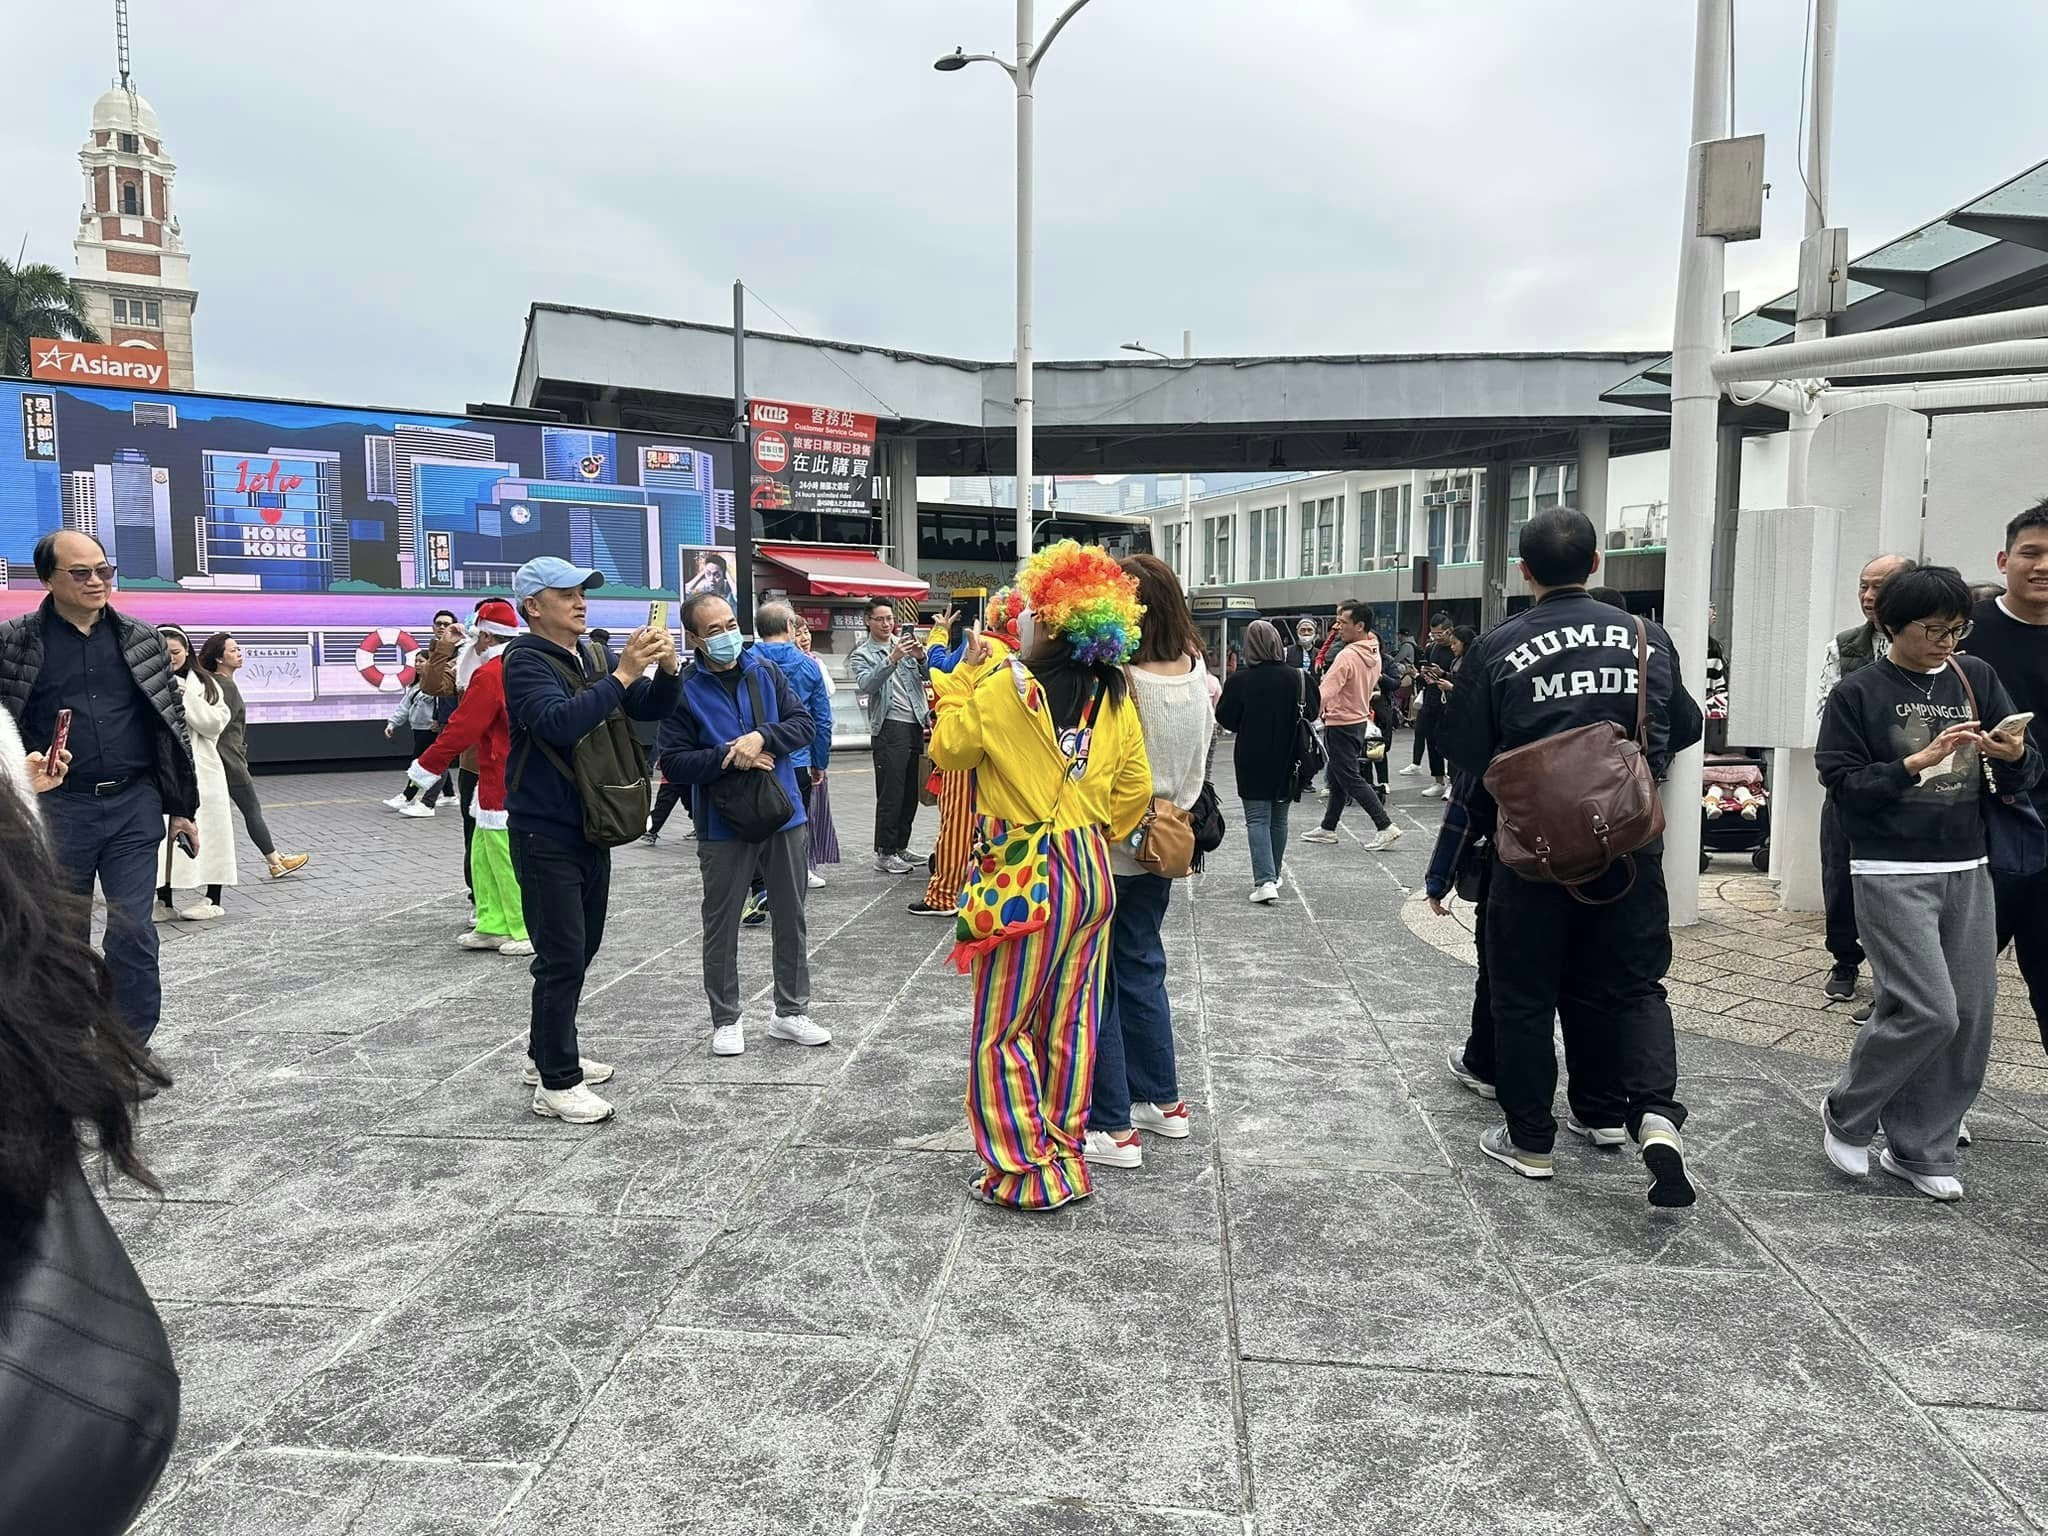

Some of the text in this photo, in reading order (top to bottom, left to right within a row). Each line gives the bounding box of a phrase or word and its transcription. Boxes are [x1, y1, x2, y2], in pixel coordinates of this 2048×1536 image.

[70, 351, 162, 385] Asiaray
[754, 405, 789, 424] KMB
[811, 407, 855, 428] 客務站
[794, 423, 869, 438] Customer Service Centre
[792, 452, 869, 479] 在此購買
[242, 526, 307, 541] HONG
[243, 542, 308, 557] KONG
[1896, 703, 1973, 719] CAMPINGCLUB
